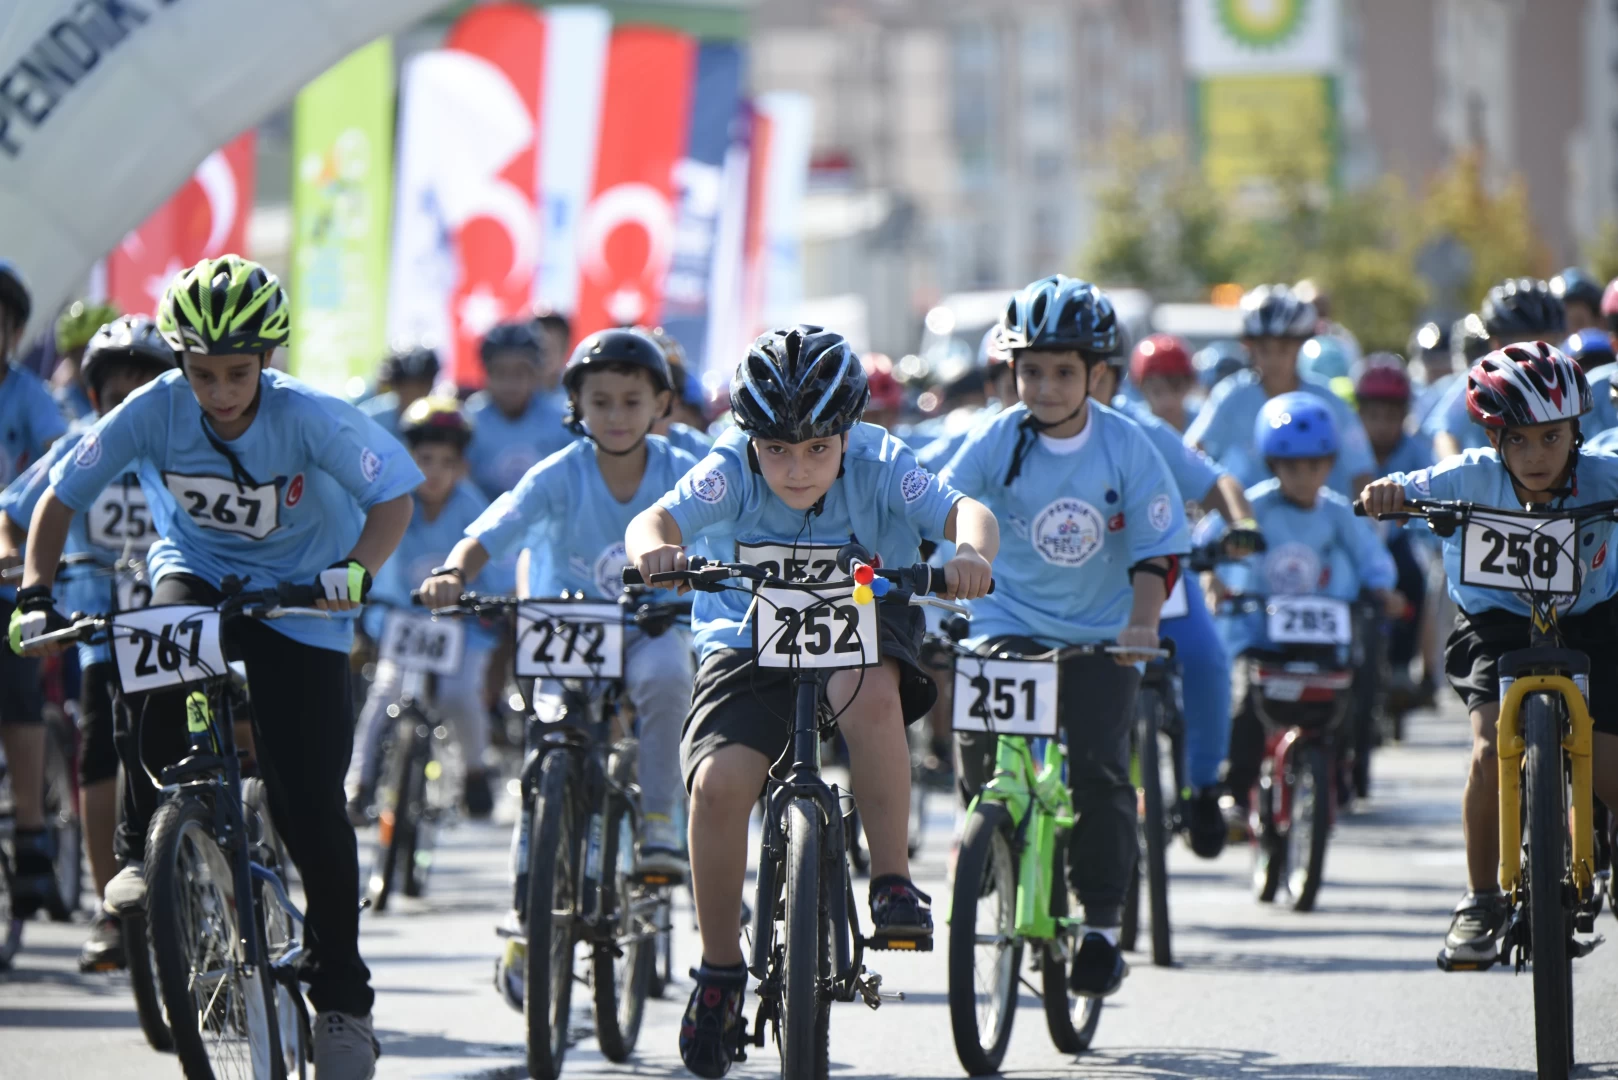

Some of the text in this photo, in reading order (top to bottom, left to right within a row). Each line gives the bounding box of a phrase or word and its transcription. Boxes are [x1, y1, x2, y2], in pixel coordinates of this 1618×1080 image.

[104, 502, 156, 538] 25
[184, 489, 261, 529] 267
[1480, 530, 1558, 579] 258
[130, 619, 204, 679] 267
[533, 618, 605, 664] 272
[775, 605, 861, 656] 252
[969, 676, 1037, 722] 251
